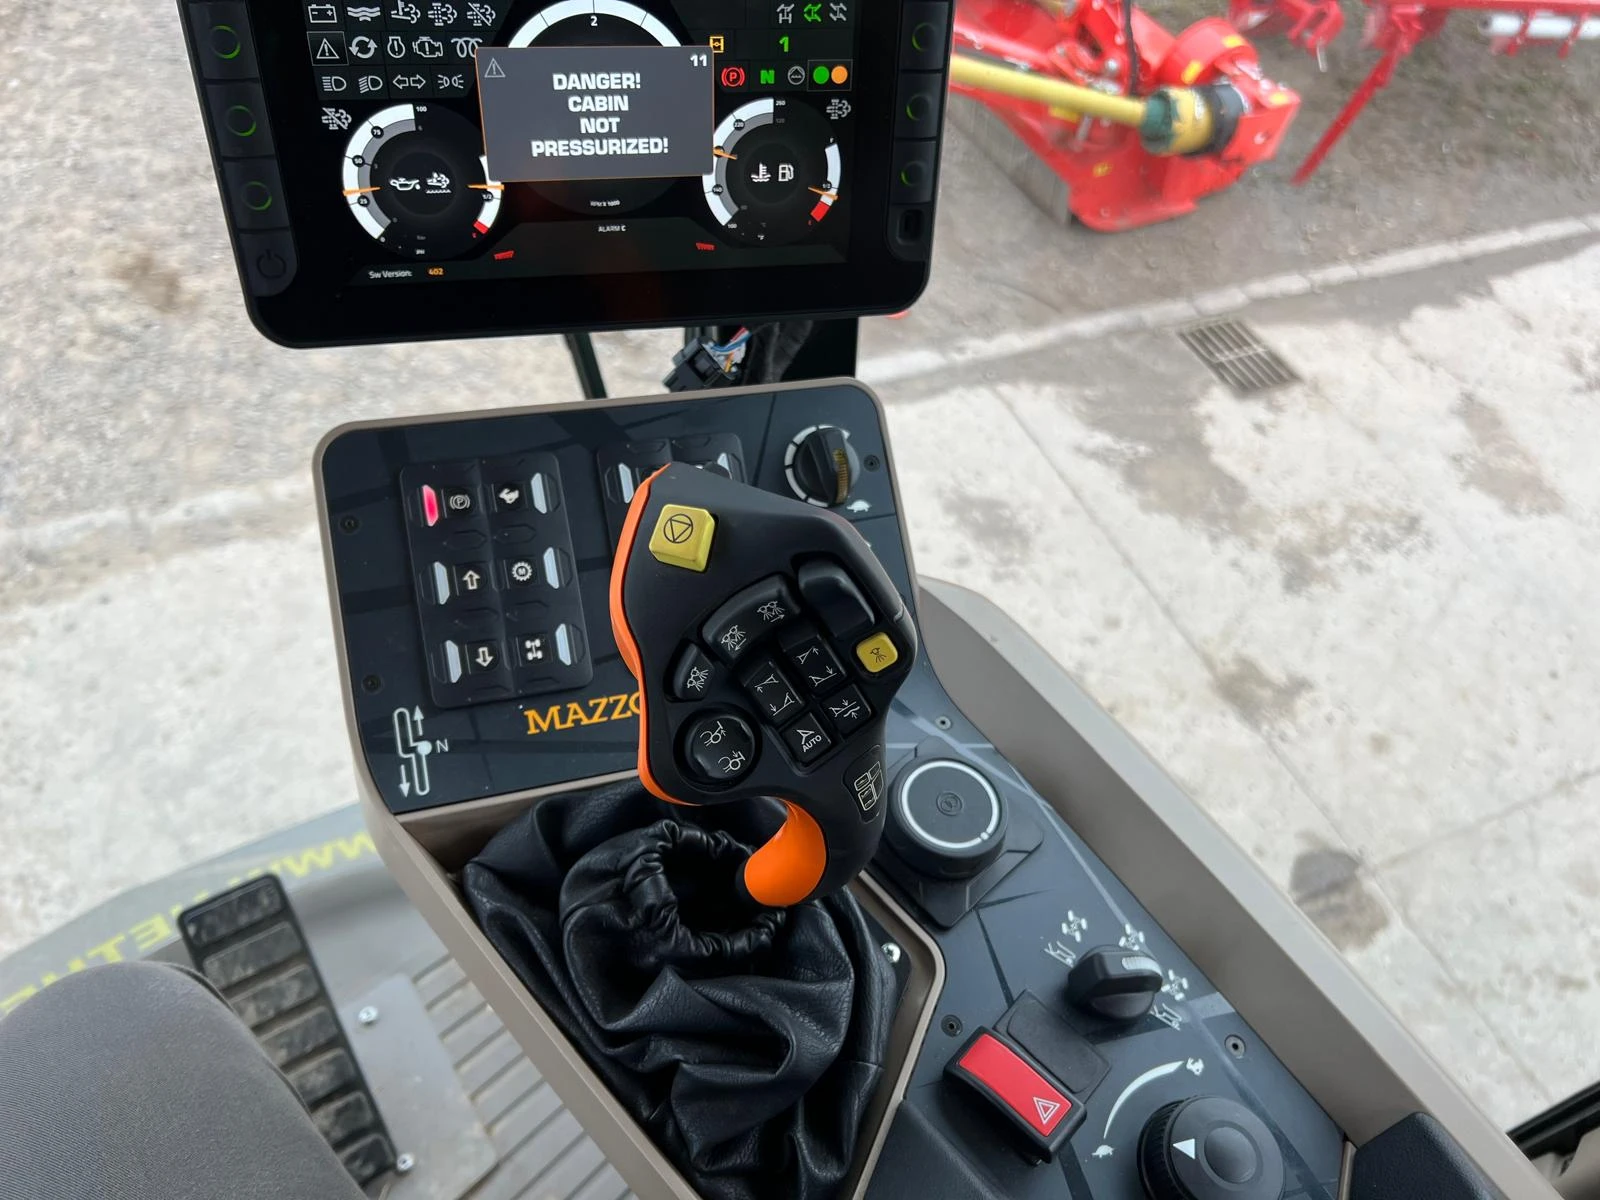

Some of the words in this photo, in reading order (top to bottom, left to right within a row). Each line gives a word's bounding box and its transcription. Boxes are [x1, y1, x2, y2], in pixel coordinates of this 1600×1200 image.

[590, 16, 599, 27] 2
[779, 36, 789, 52] 1
[690, 54, 708, 67] 11
[552, 72, 642, 91] DANGER!
[760, 69, 775, 84] N
[567, 95, 630, 112] CABIN
[580, 117, 621, 134] NOT
[531, 138, 669, 158] PRESSURIZED!
[482, 192, 493, 201] 1/2
[368, 270, 383, 279] Sw
[428, 268, 444, 276] 402
[436, 739, 449, 753] N
[801, 734, 823, 753] AUTO
